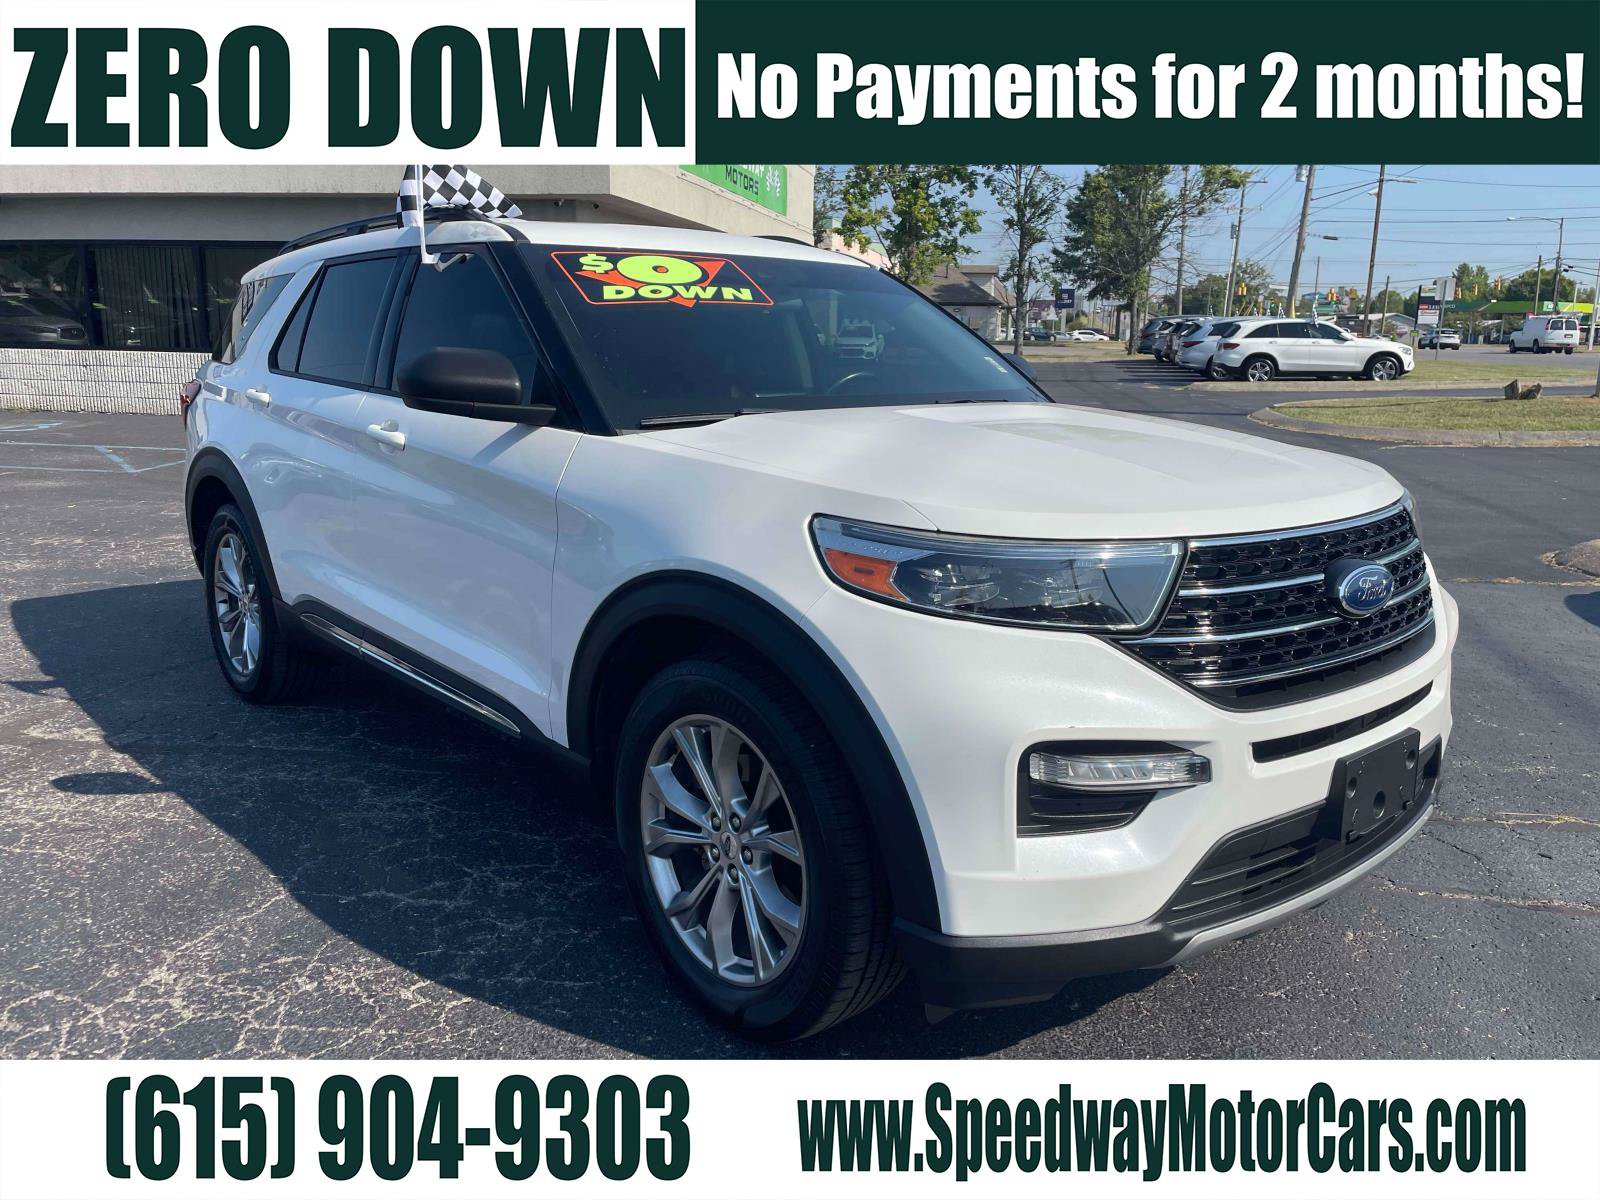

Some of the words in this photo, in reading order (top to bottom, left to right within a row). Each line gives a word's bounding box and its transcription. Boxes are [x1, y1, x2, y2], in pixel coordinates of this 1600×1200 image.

[725, 164, 759, 196] MOTORS
[602, 284, 754, 300] DOWN
[1357, 575, 1387, 600] Ford
